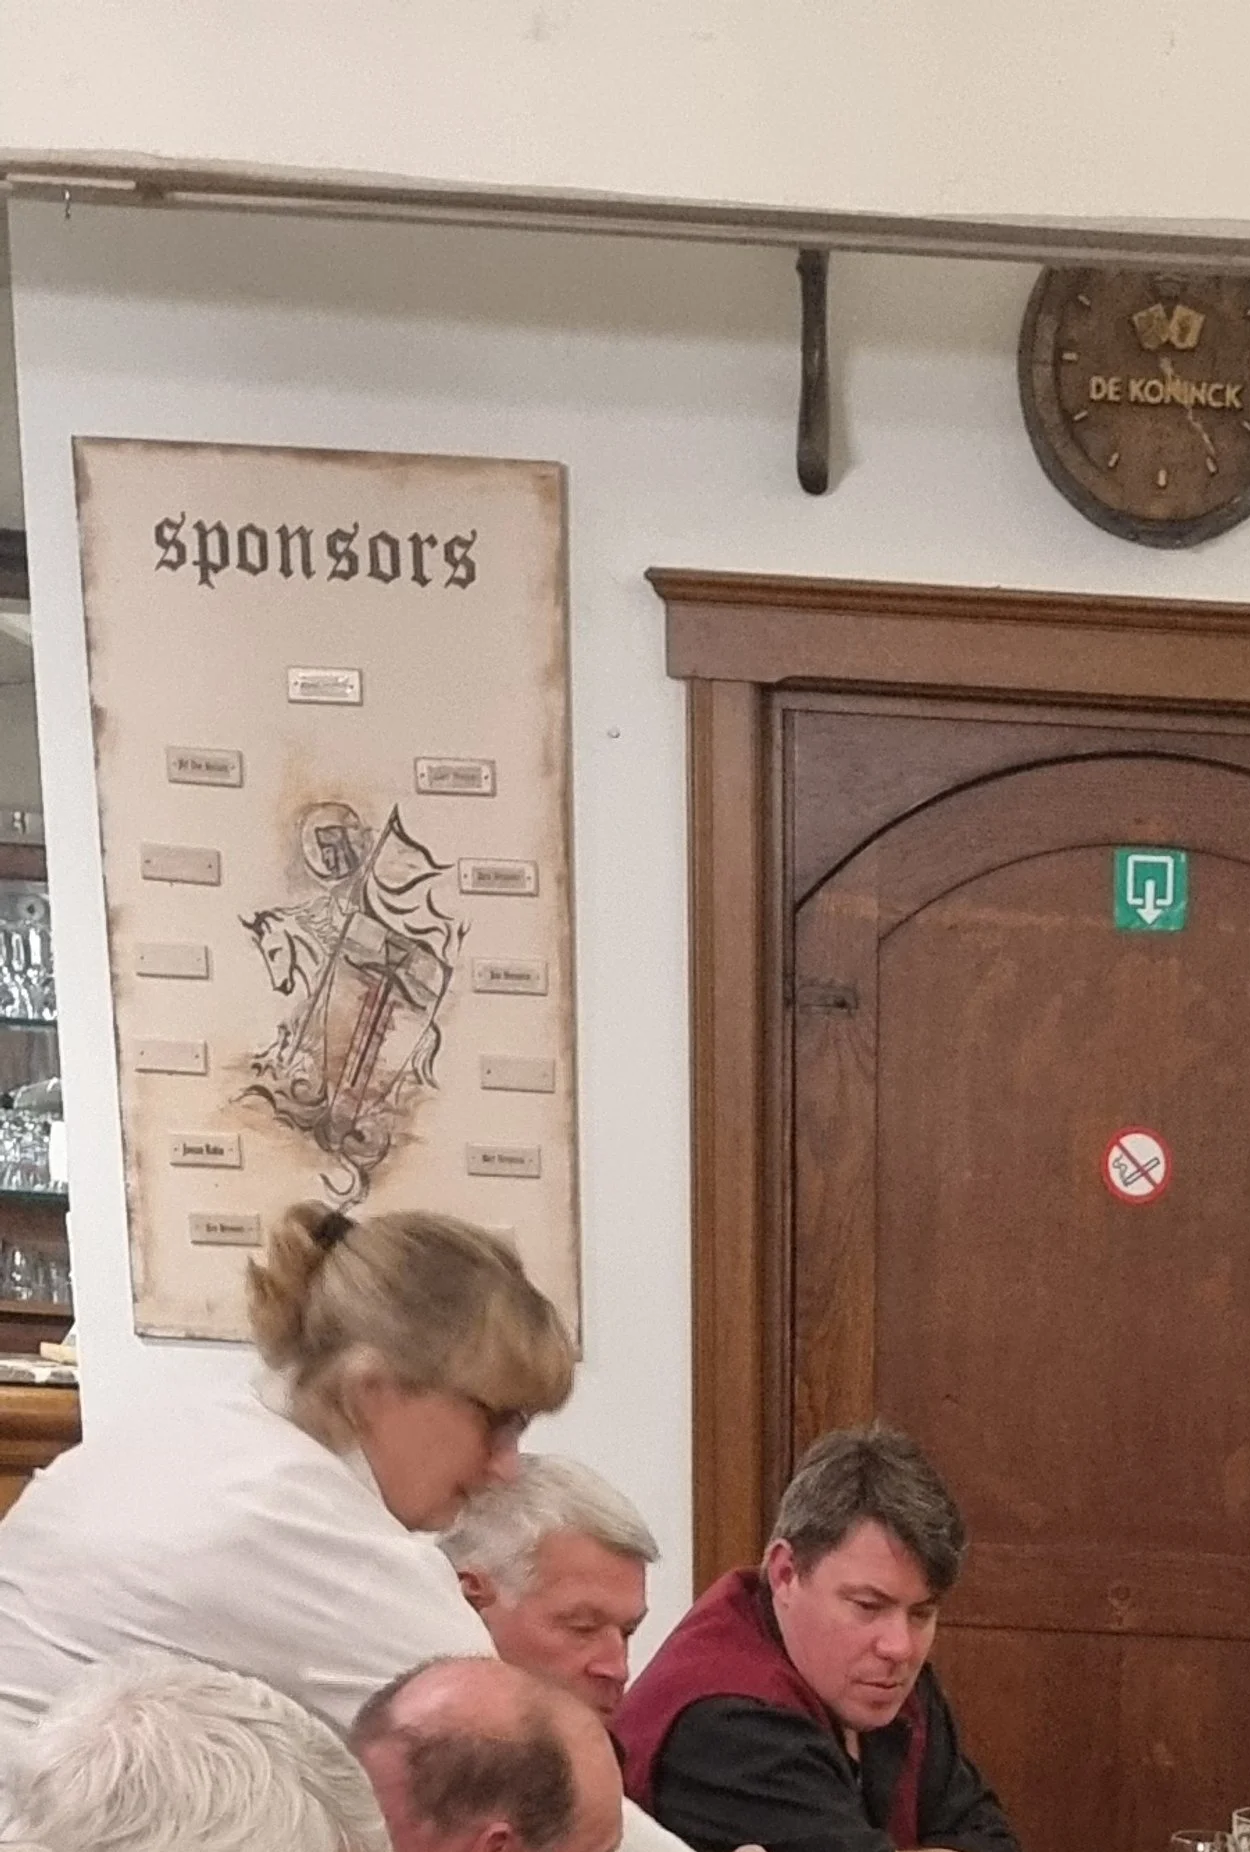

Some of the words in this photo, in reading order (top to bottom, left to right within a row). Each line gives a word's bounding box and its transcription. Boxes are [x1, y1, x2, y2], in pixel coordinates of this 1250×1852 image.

[1090, 375, 1122, 401] DE
[1129, 378, 1243, 409] KONINCK
[154, 510, 478, 590] sponsors
